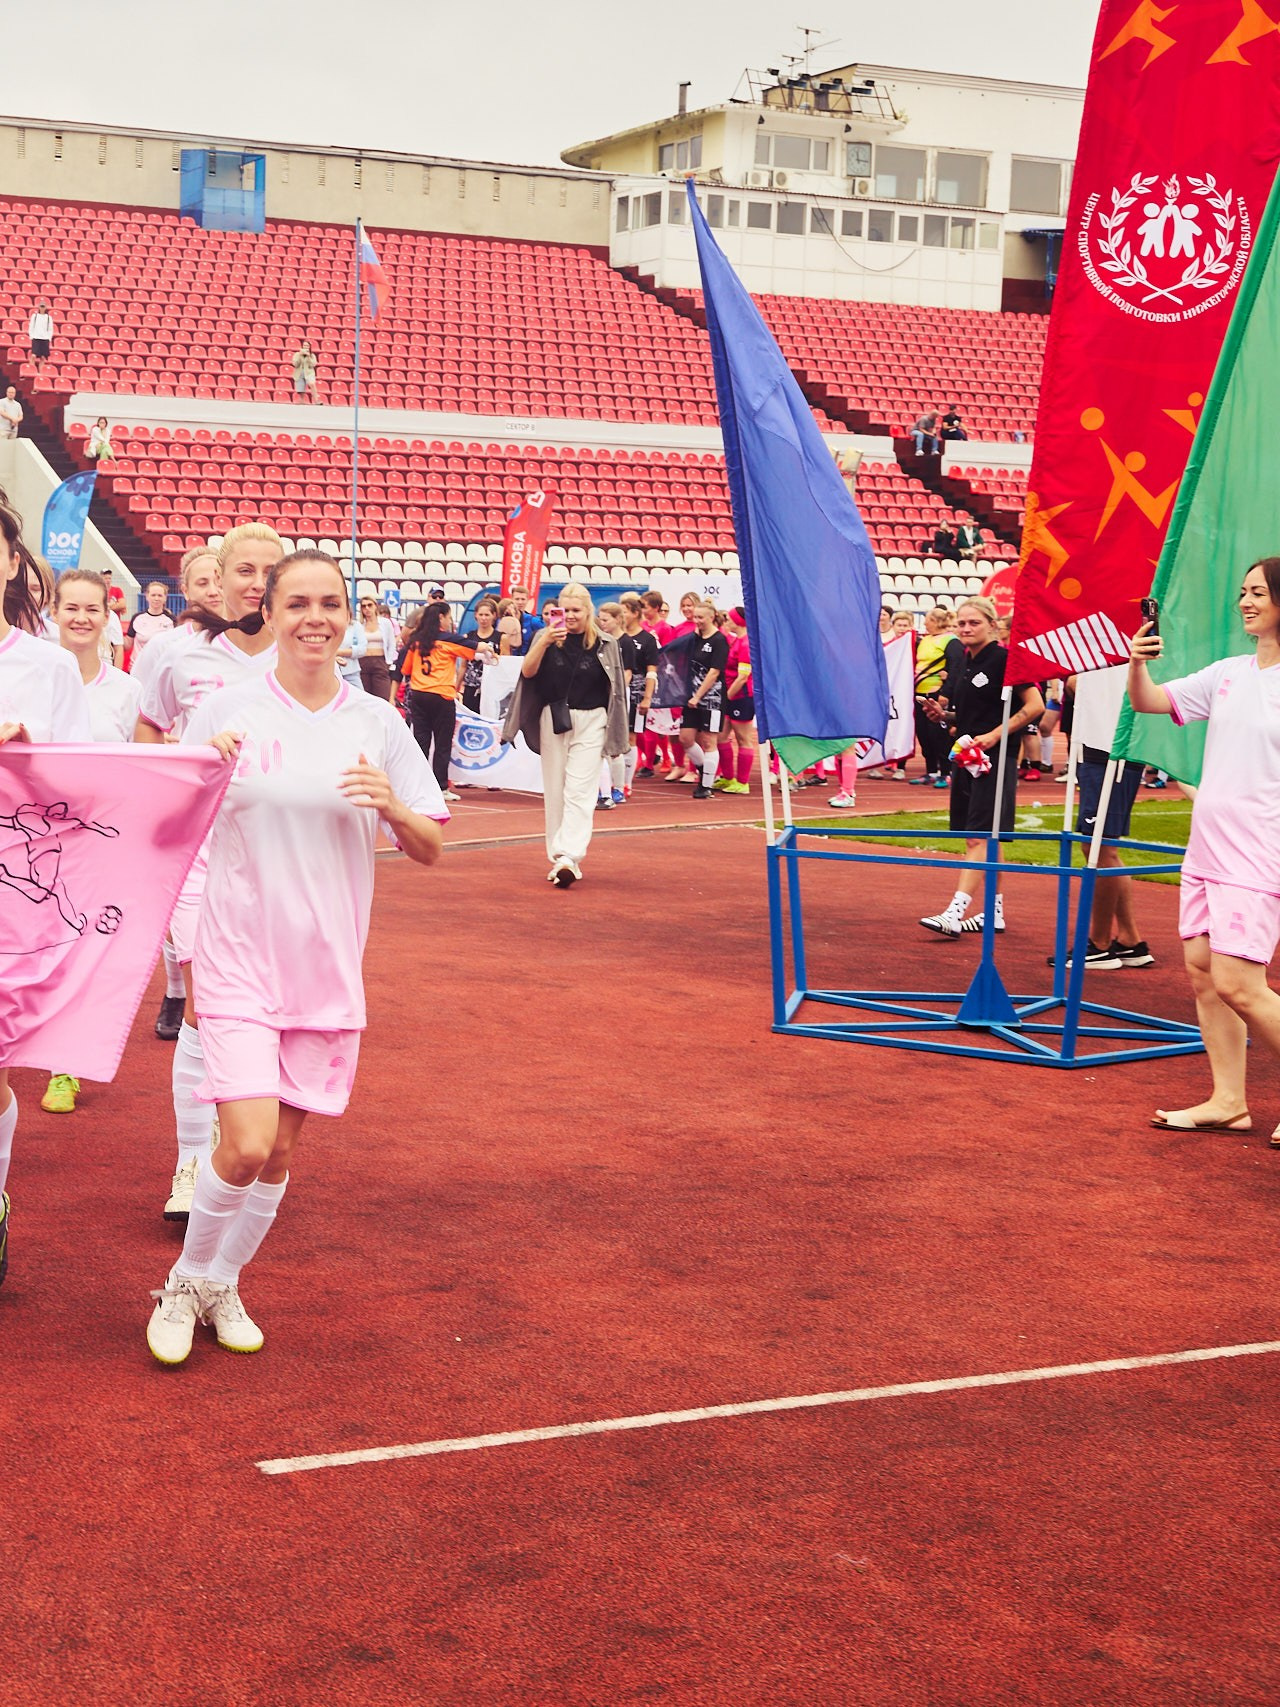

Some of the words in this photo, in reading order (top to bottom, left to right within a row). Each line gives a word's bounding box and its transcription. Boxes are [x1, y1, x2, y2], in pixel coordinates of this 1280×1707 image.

[1079, 192, 1101, 232] ЦЕНТР
[1236, 196, 1252, 249] ОБЛАСТИ
[1078, 232, 1113, 297] СПОРТИВНОЙ
[1183, 250, 1249, 320] НИЖЕГОРОДСКОЙ
[1108, 292, 1181, 323] ПОДГОТОВКИ
